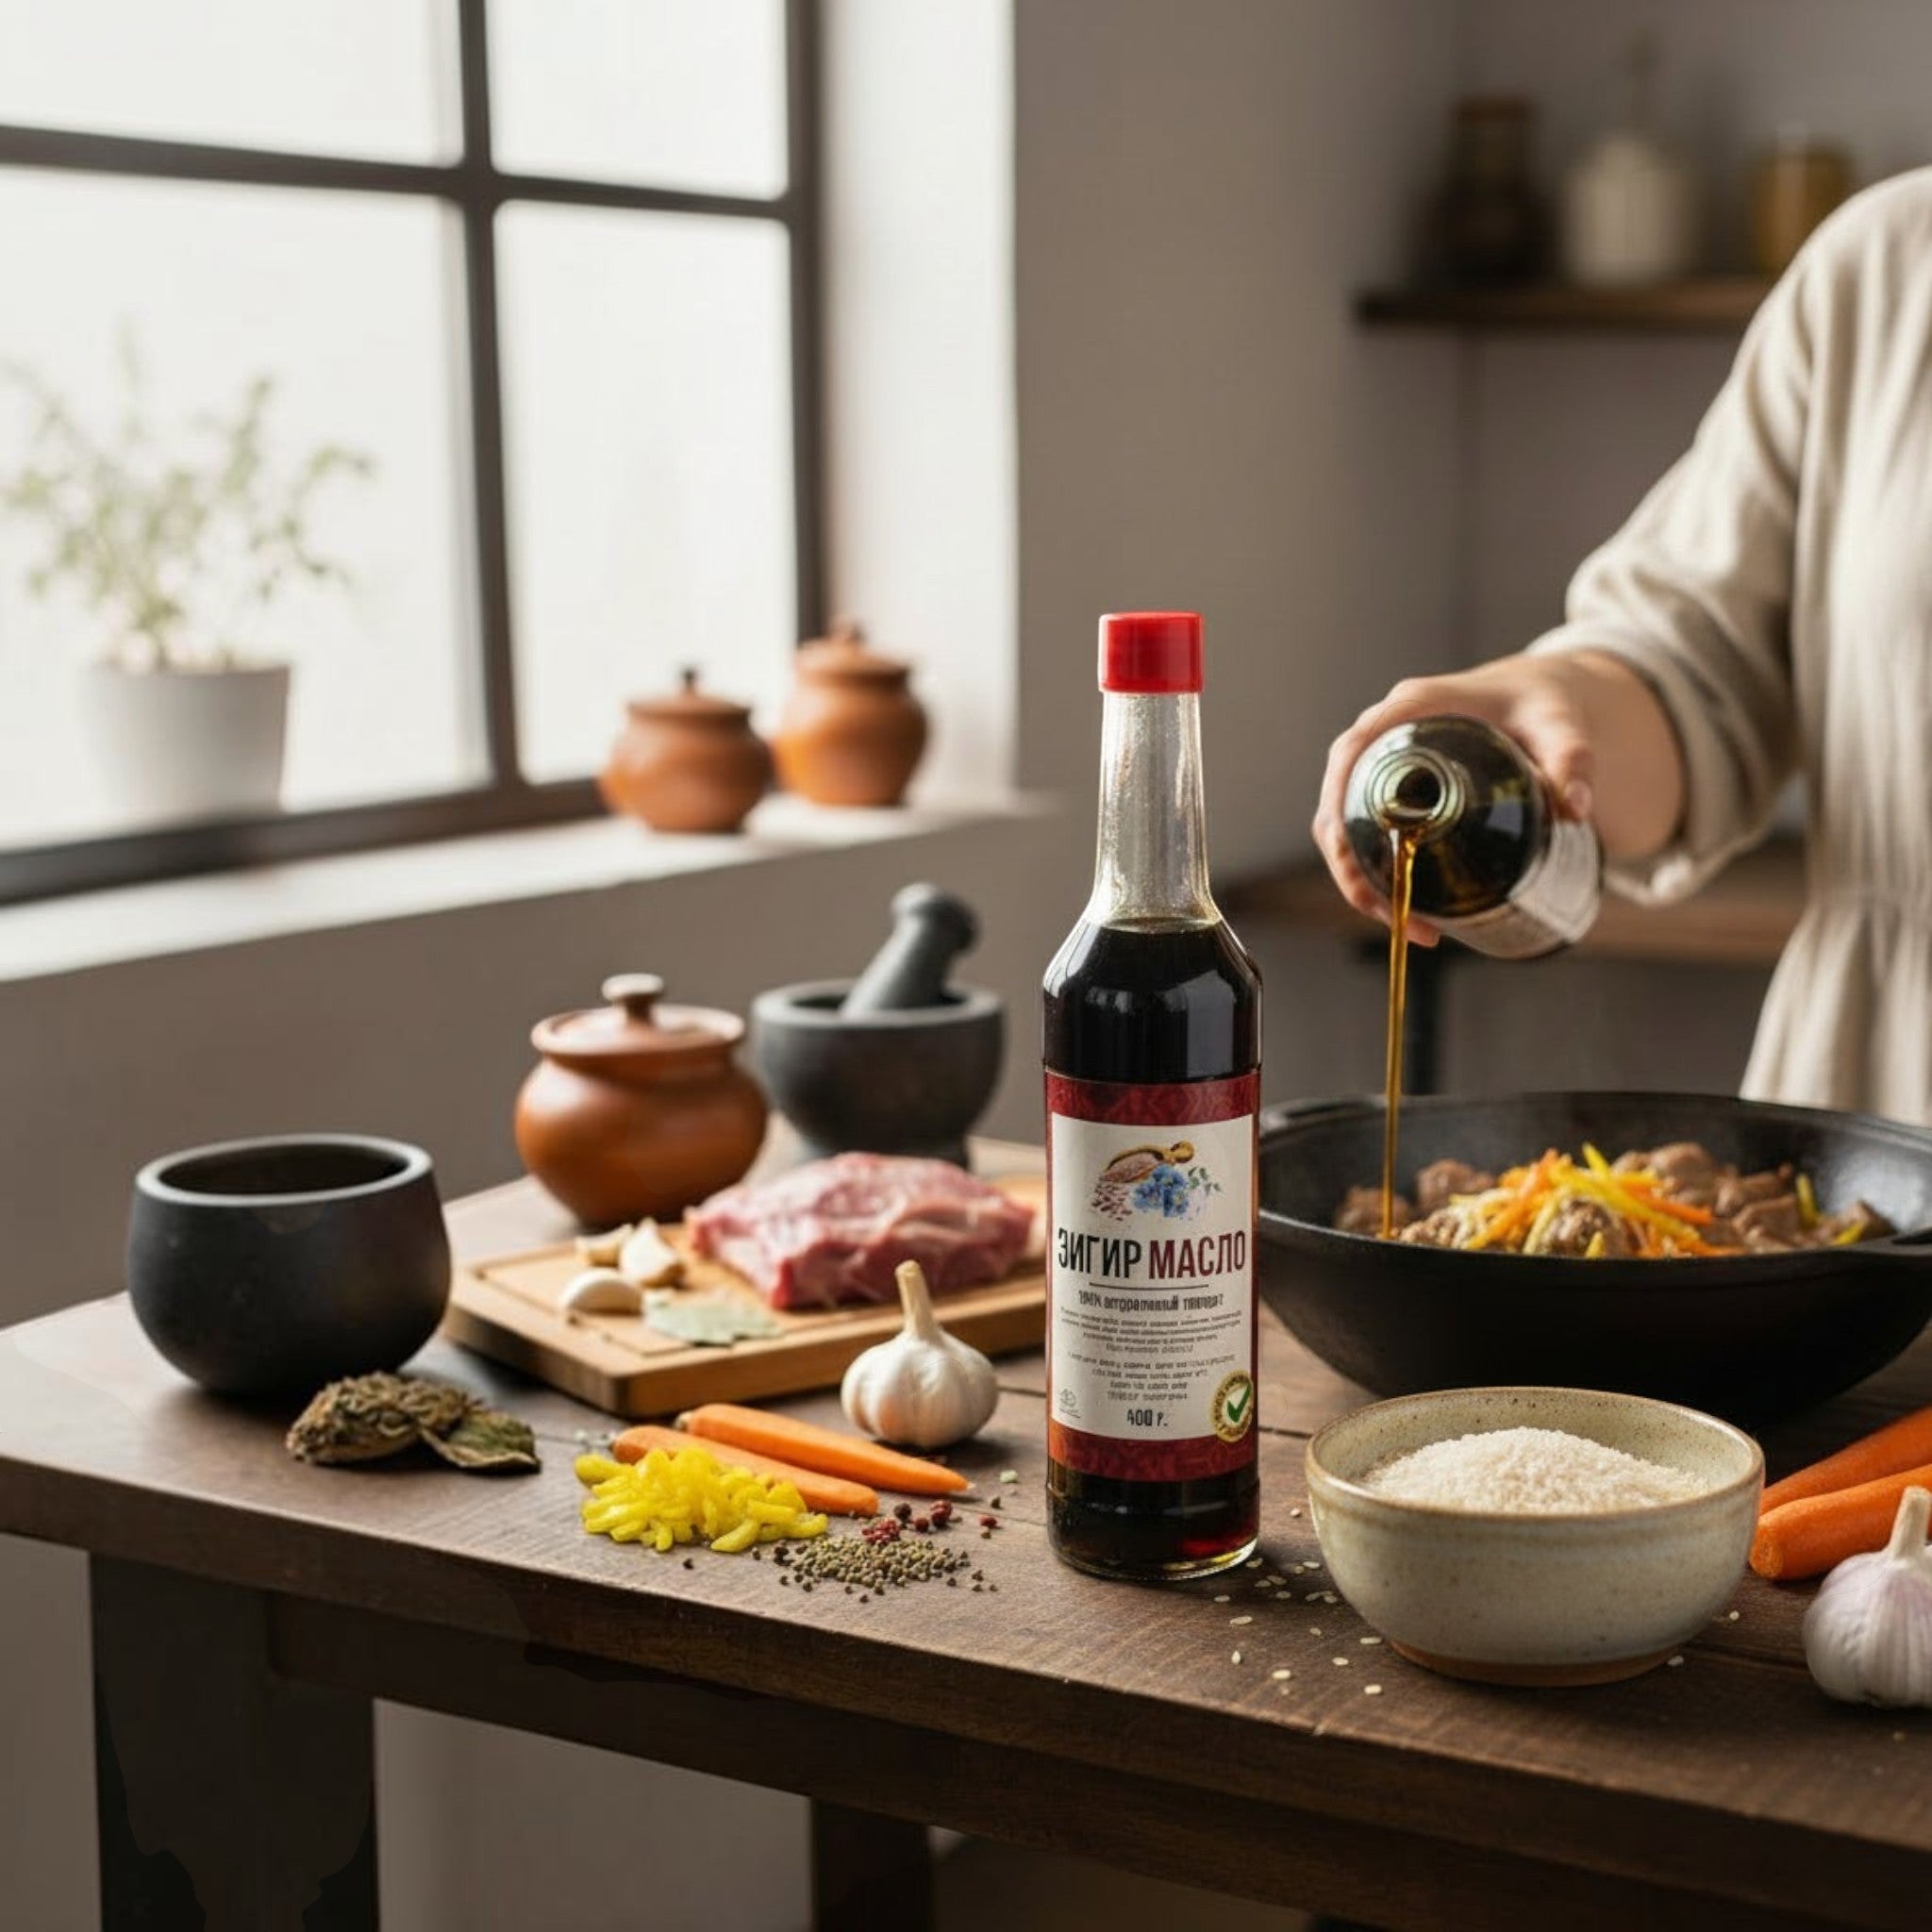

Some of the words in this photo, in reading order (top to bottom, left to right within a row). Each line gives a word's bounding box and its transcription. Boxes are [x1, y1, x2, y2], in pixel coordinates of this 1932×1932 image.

[1058, 1227, 1141, 1279] ЗИГИР
[1148, 1230, 1245, 1280] МАСЛО
[1126, 1408, 1153, 1426] 400
